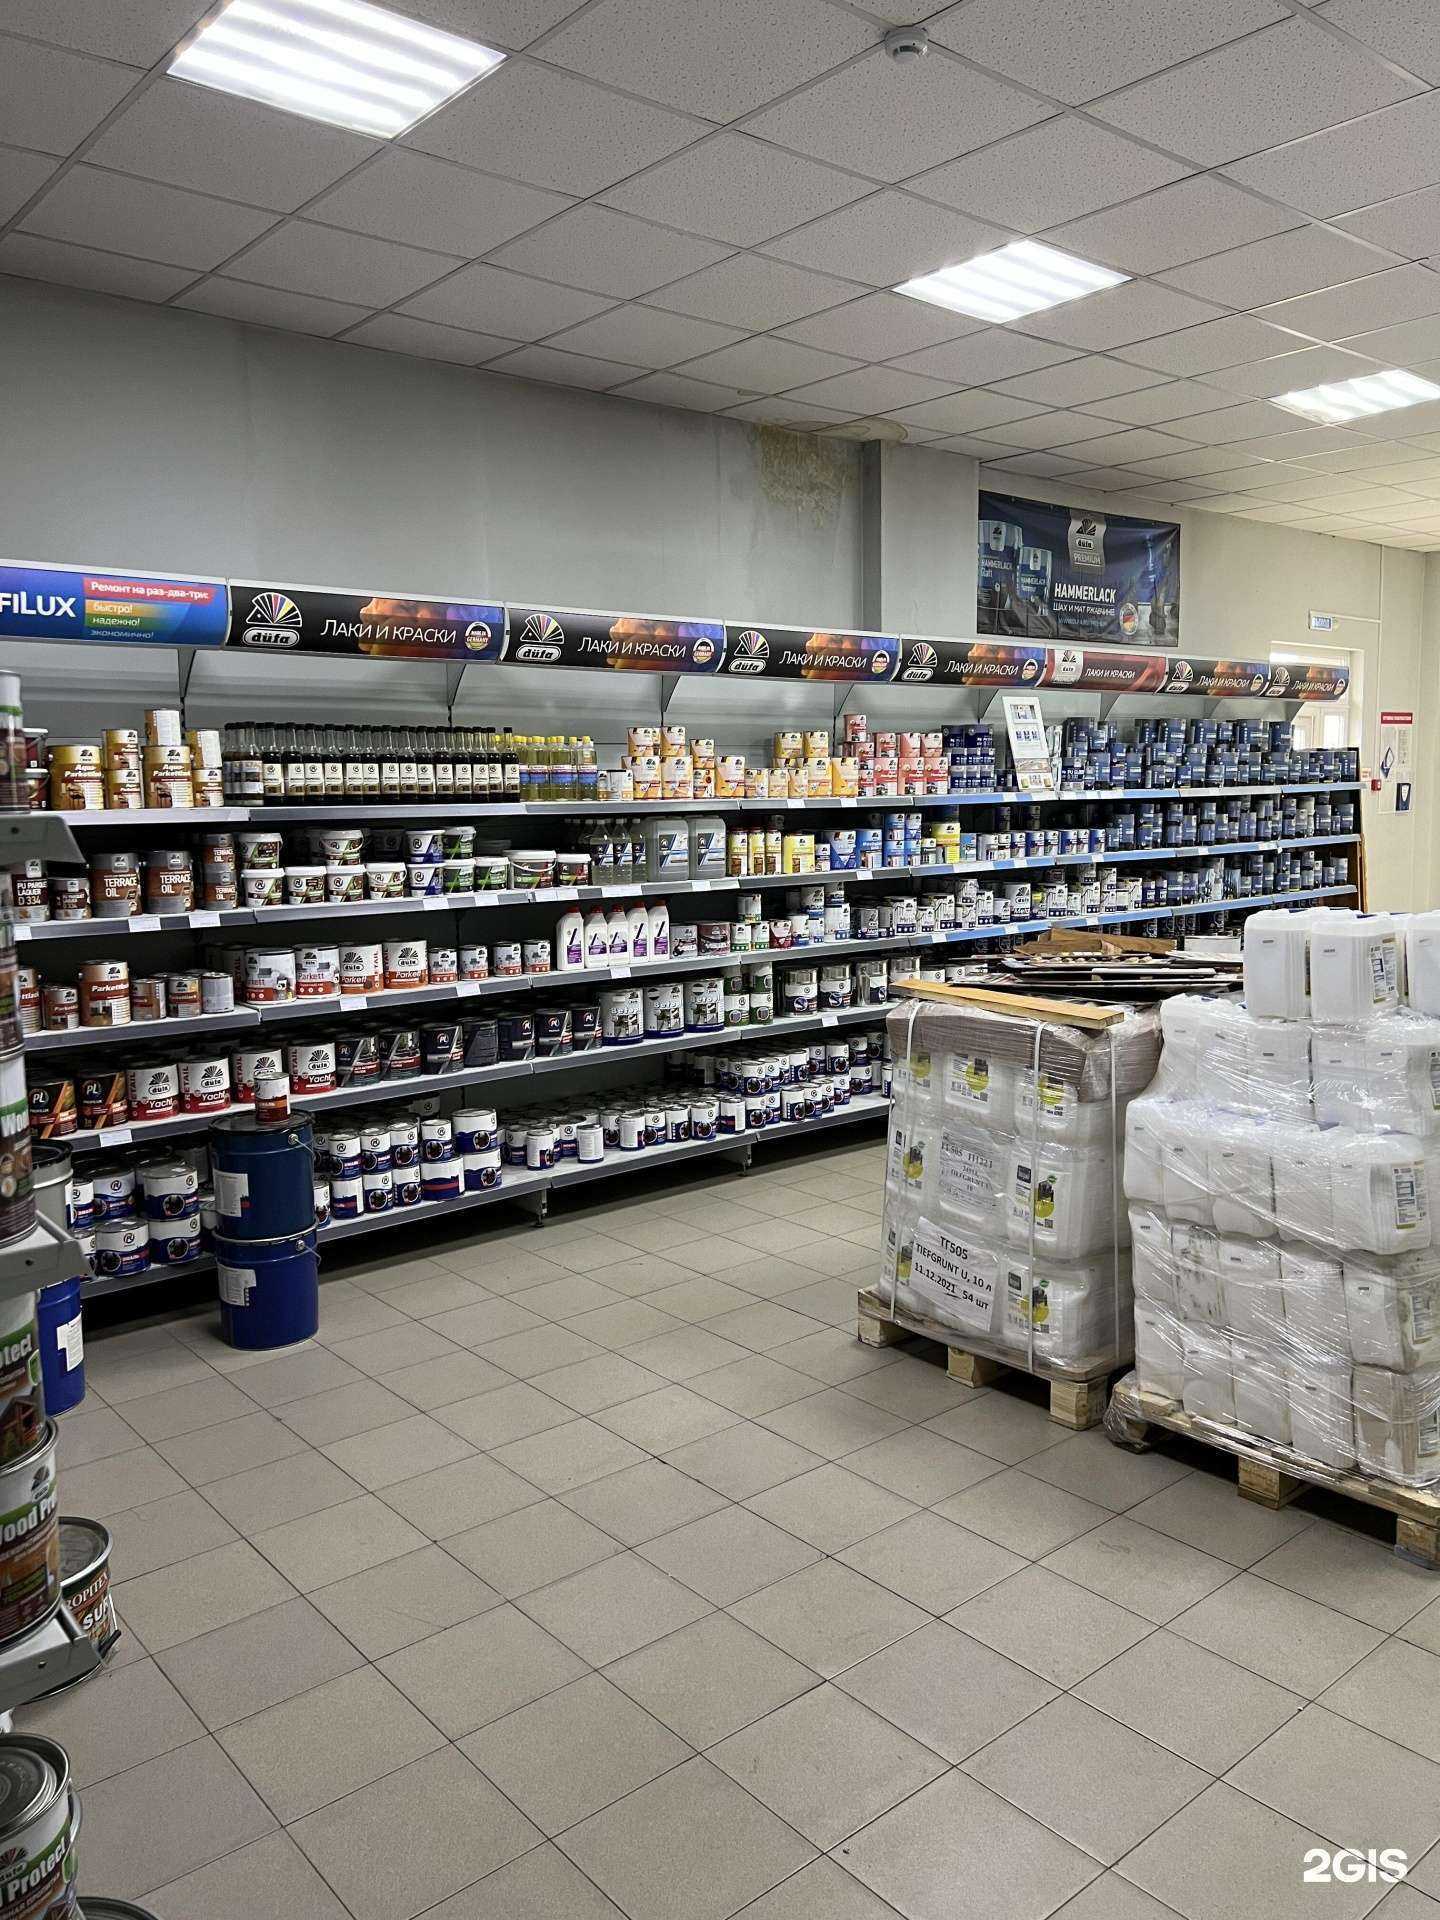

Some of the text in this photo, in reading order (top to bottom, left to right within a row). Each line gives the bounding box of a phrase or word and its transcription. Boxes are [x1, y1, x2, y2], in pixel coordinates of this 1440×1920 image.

[1073, 553, 1100, 564] PREMIUM
[91, 582, 131, 593] Ремонт
[132, 586, 146, 594] на
[1054, 583, 1116, 603] HAMMERLACK
[94, 602, 133, 614] быстро!
[1053, 602, 1115, 616] ШАХ И МАТ РЖАВЧИНЕ
[93, 617, 140, 627] надежно!
[90, 629, 154, 639] экономично!
[320, 619, 457, 643] ЛАКИ И КРАСКИ
[251, 633, 290, 644] düfa
[578, 637, 686, 658] ЛАКИ И КРАСКИ
[523, 649, 553, 659] düfa
[779, 651, 867, 668] ЛАКИ И КРАСКИ
[944, 660, 1019, 676] ЛАКИ И КРАСКИ
[104, 877, 137, 887] TERRACE
[160, 874, 191, 884] TERRACE
[106, 888, 120, 897] OIL
[161, 885, 175, 894] OIL
[18, 896, 41, 905] D 334
[915, 1243, 960, 1276] TIEFGRUNT
[961, 1269, 970, 1283] U,
[973, 1276, 984, 1288] 10
[914, 1262, 989, 1310] 11.12.2021 54 шт
[0, 1505, 38, 1545] ood
